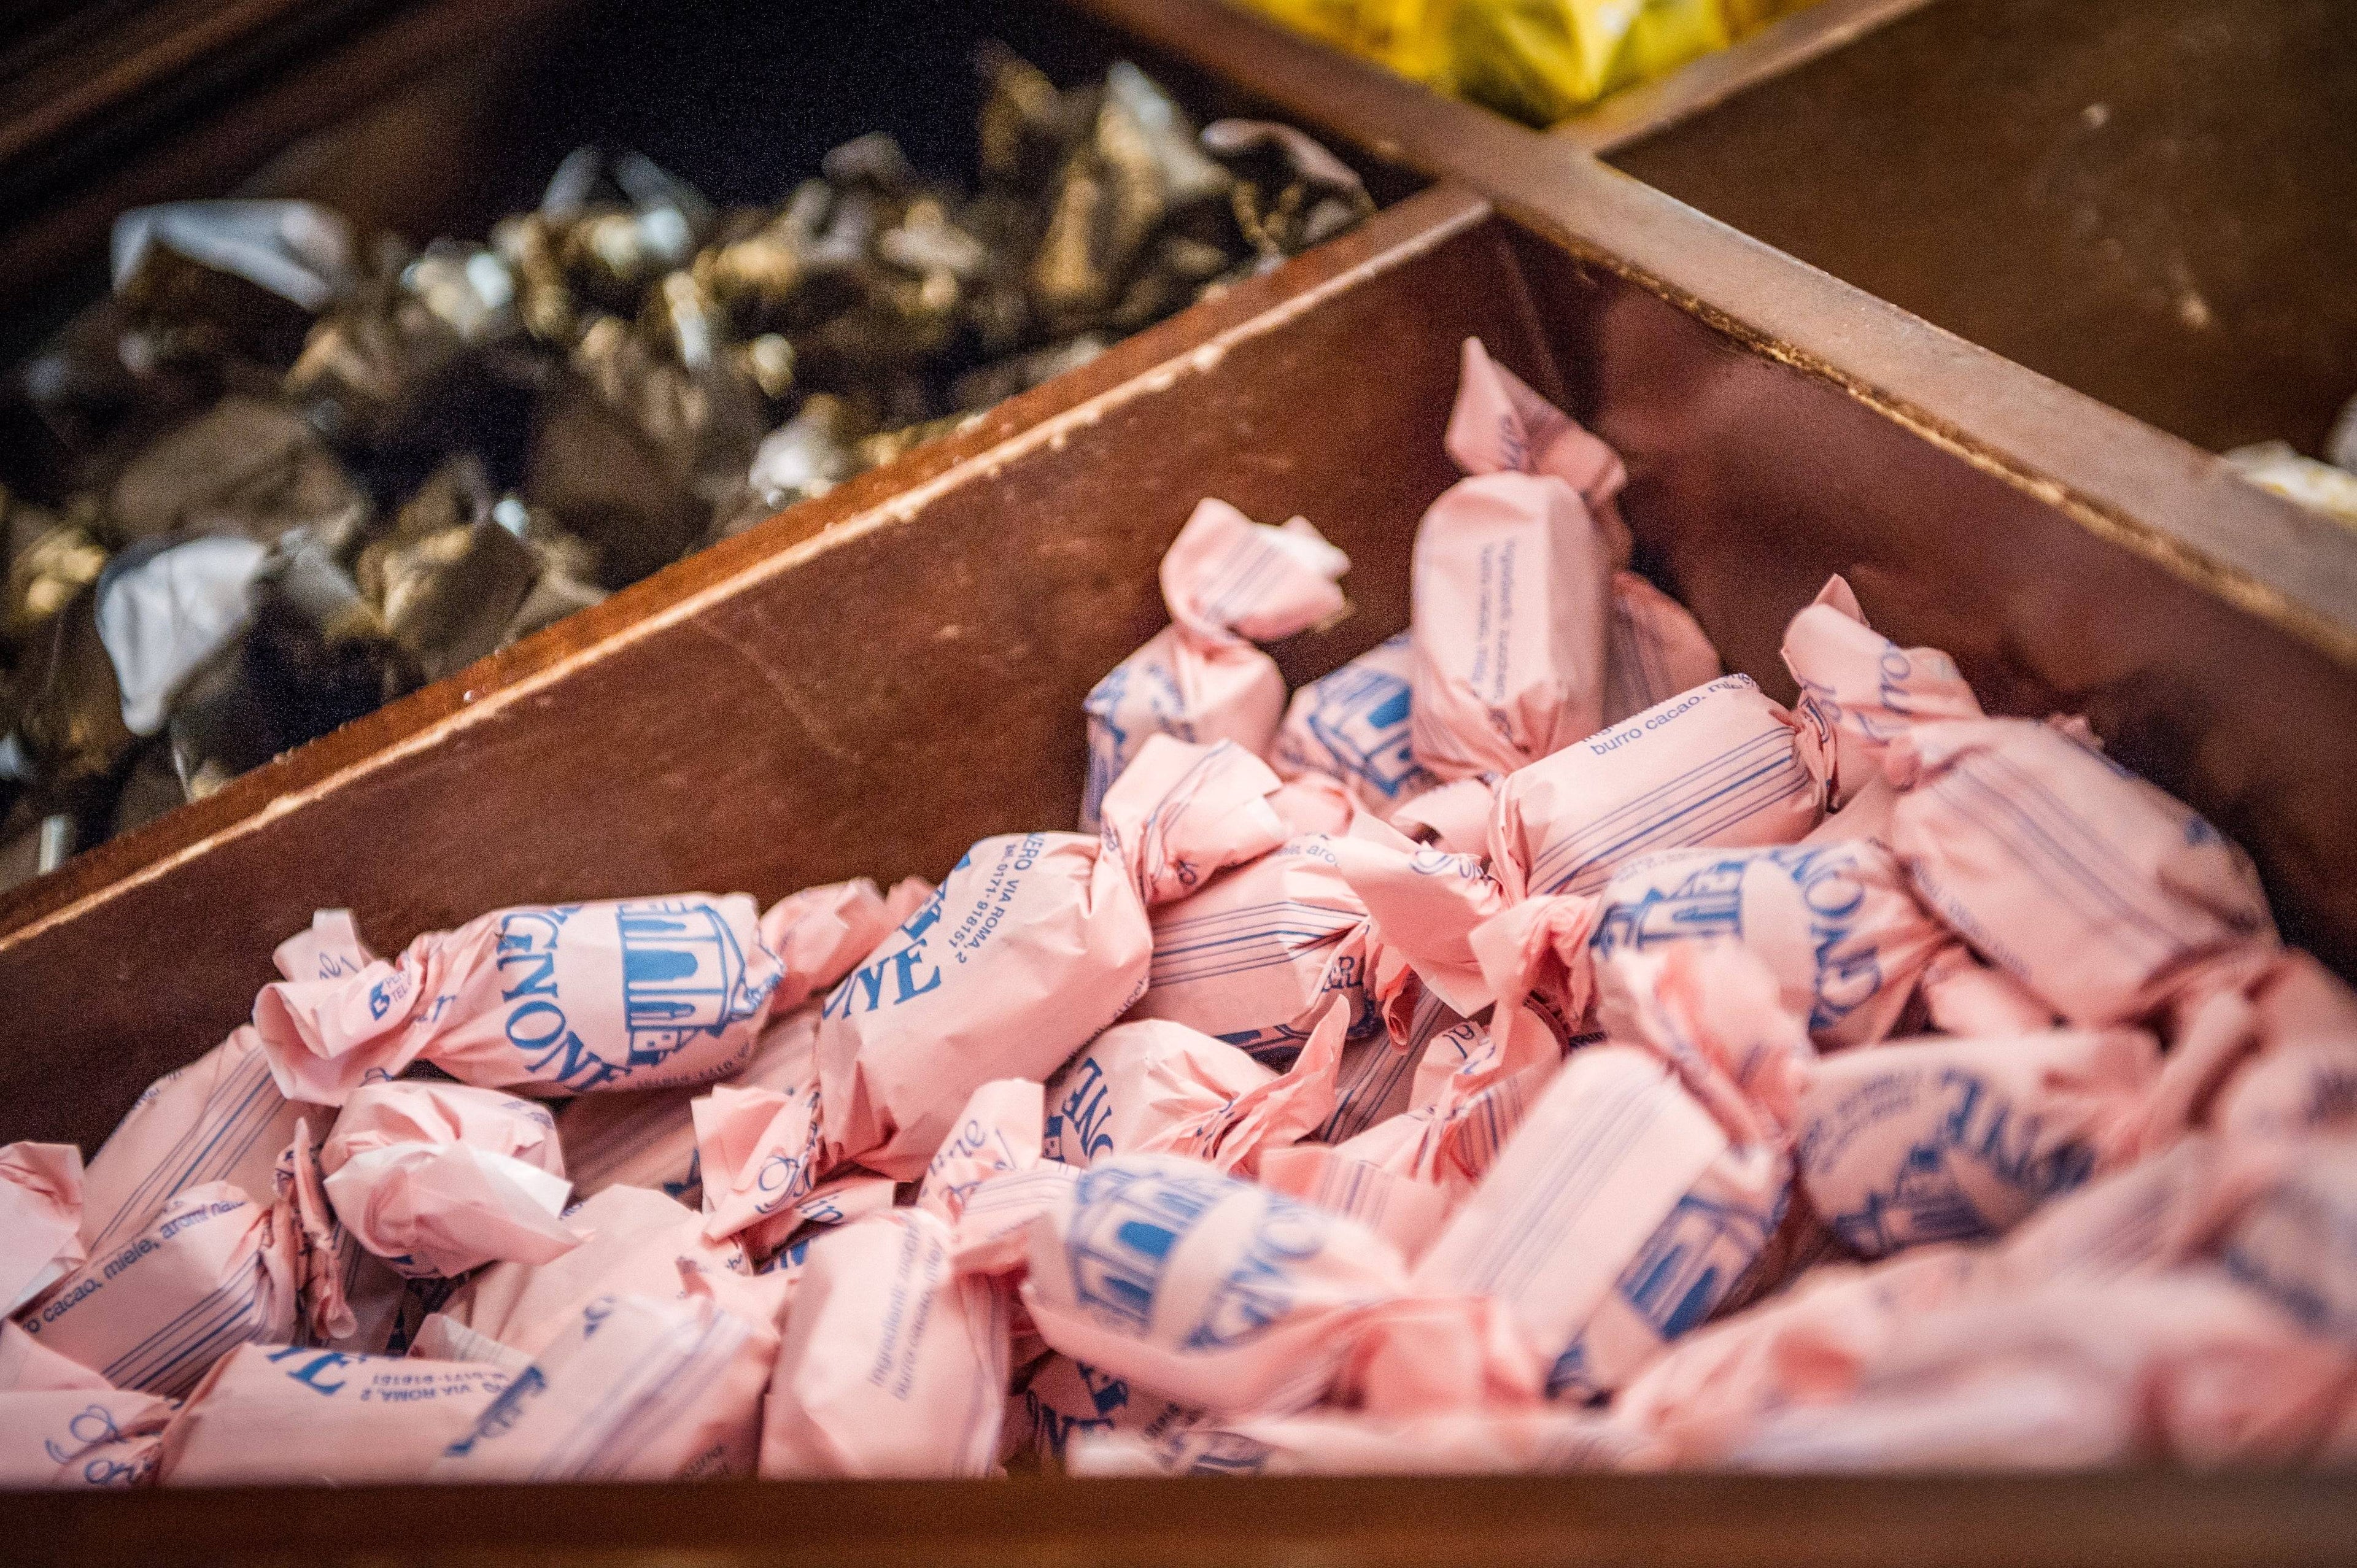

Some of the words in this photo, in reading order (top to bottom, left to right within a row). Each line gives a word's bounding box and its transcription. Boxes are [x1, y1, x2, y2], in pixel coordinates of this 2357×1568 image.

[1589, 727, 1643, 757] burro
[1005, 879, 1020, 905] VIA
[956, 952, 968, 964] 2
